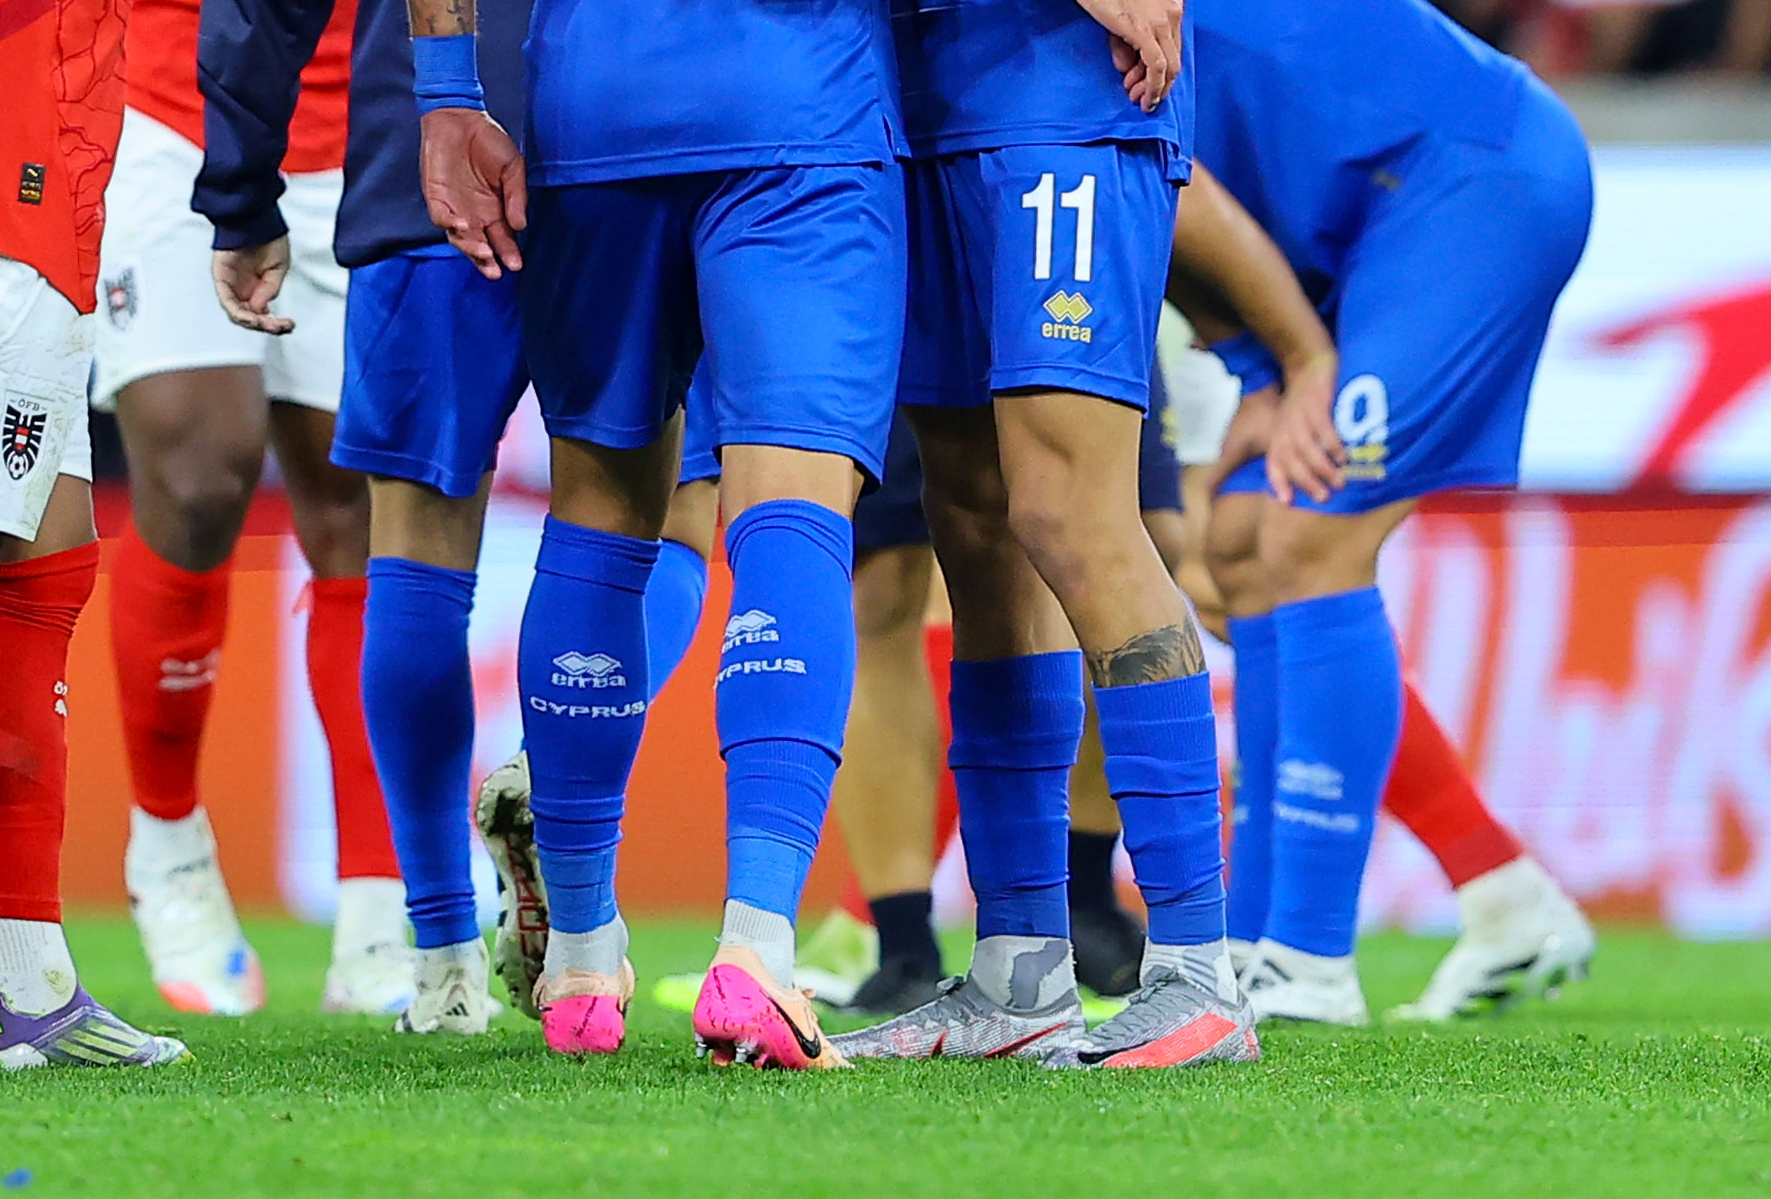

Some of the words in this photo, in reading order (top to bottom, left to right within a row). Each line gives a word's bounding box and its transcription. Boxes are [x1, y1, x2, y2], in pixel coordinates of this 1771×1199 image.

[1022, 173, 1096, 283] 11
[1042, 320, 1093, 344] errea
[551, 672, 627, 689] errea
[530, 696, 647, 719] CYPRUS
